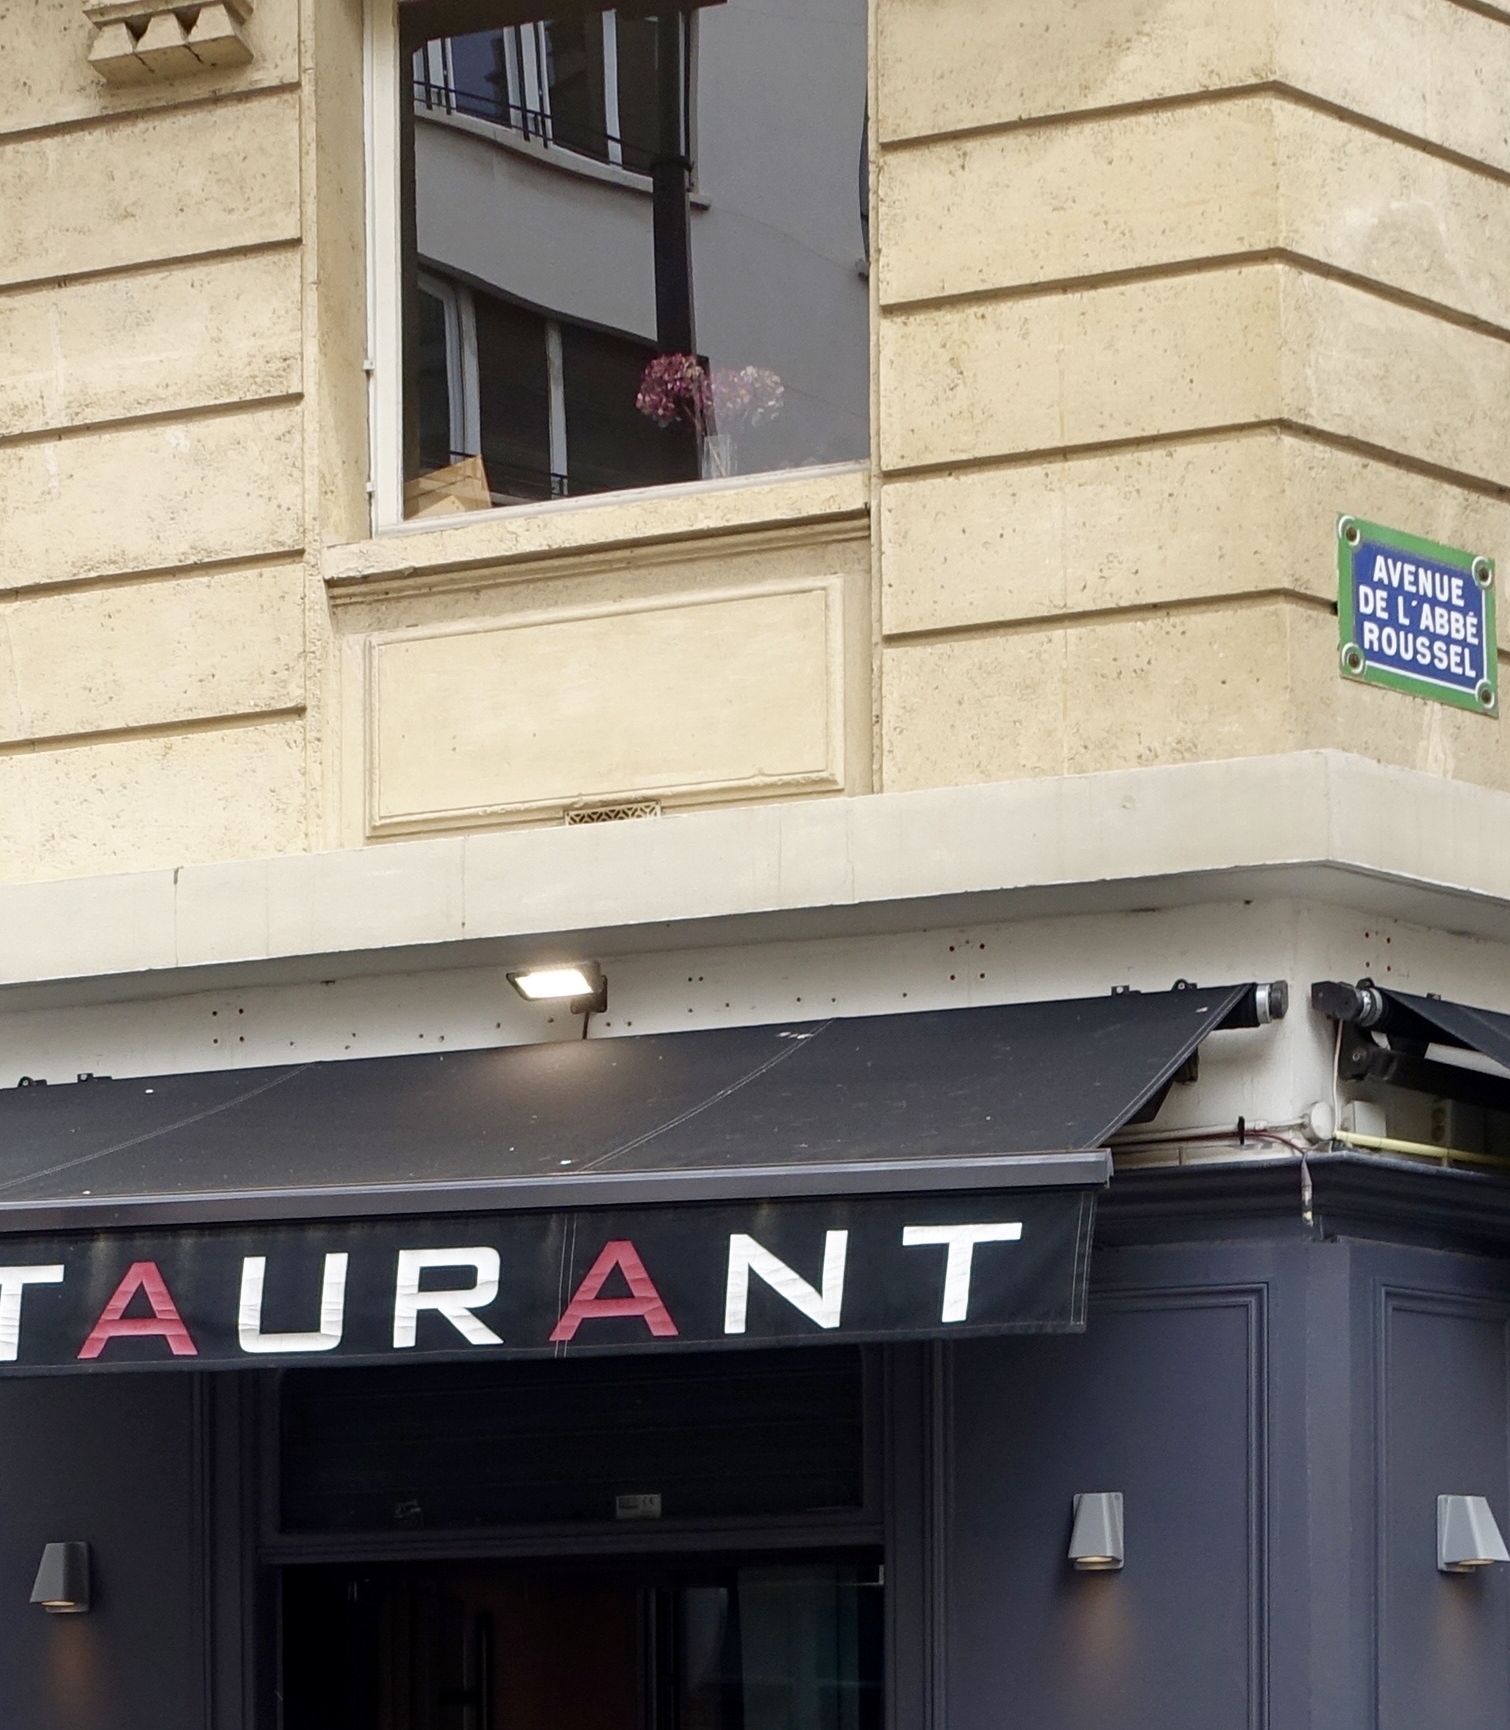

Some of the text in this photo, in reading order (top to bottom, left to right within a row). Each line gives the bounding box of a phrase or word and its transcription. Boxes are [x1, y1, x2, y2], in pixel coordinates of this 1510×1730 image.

[1359, 585, 1389, 620] DE
[1373, 555, 1465, 607] AVENUE
[1363, 621, 1477, 678] ROUSSEL
